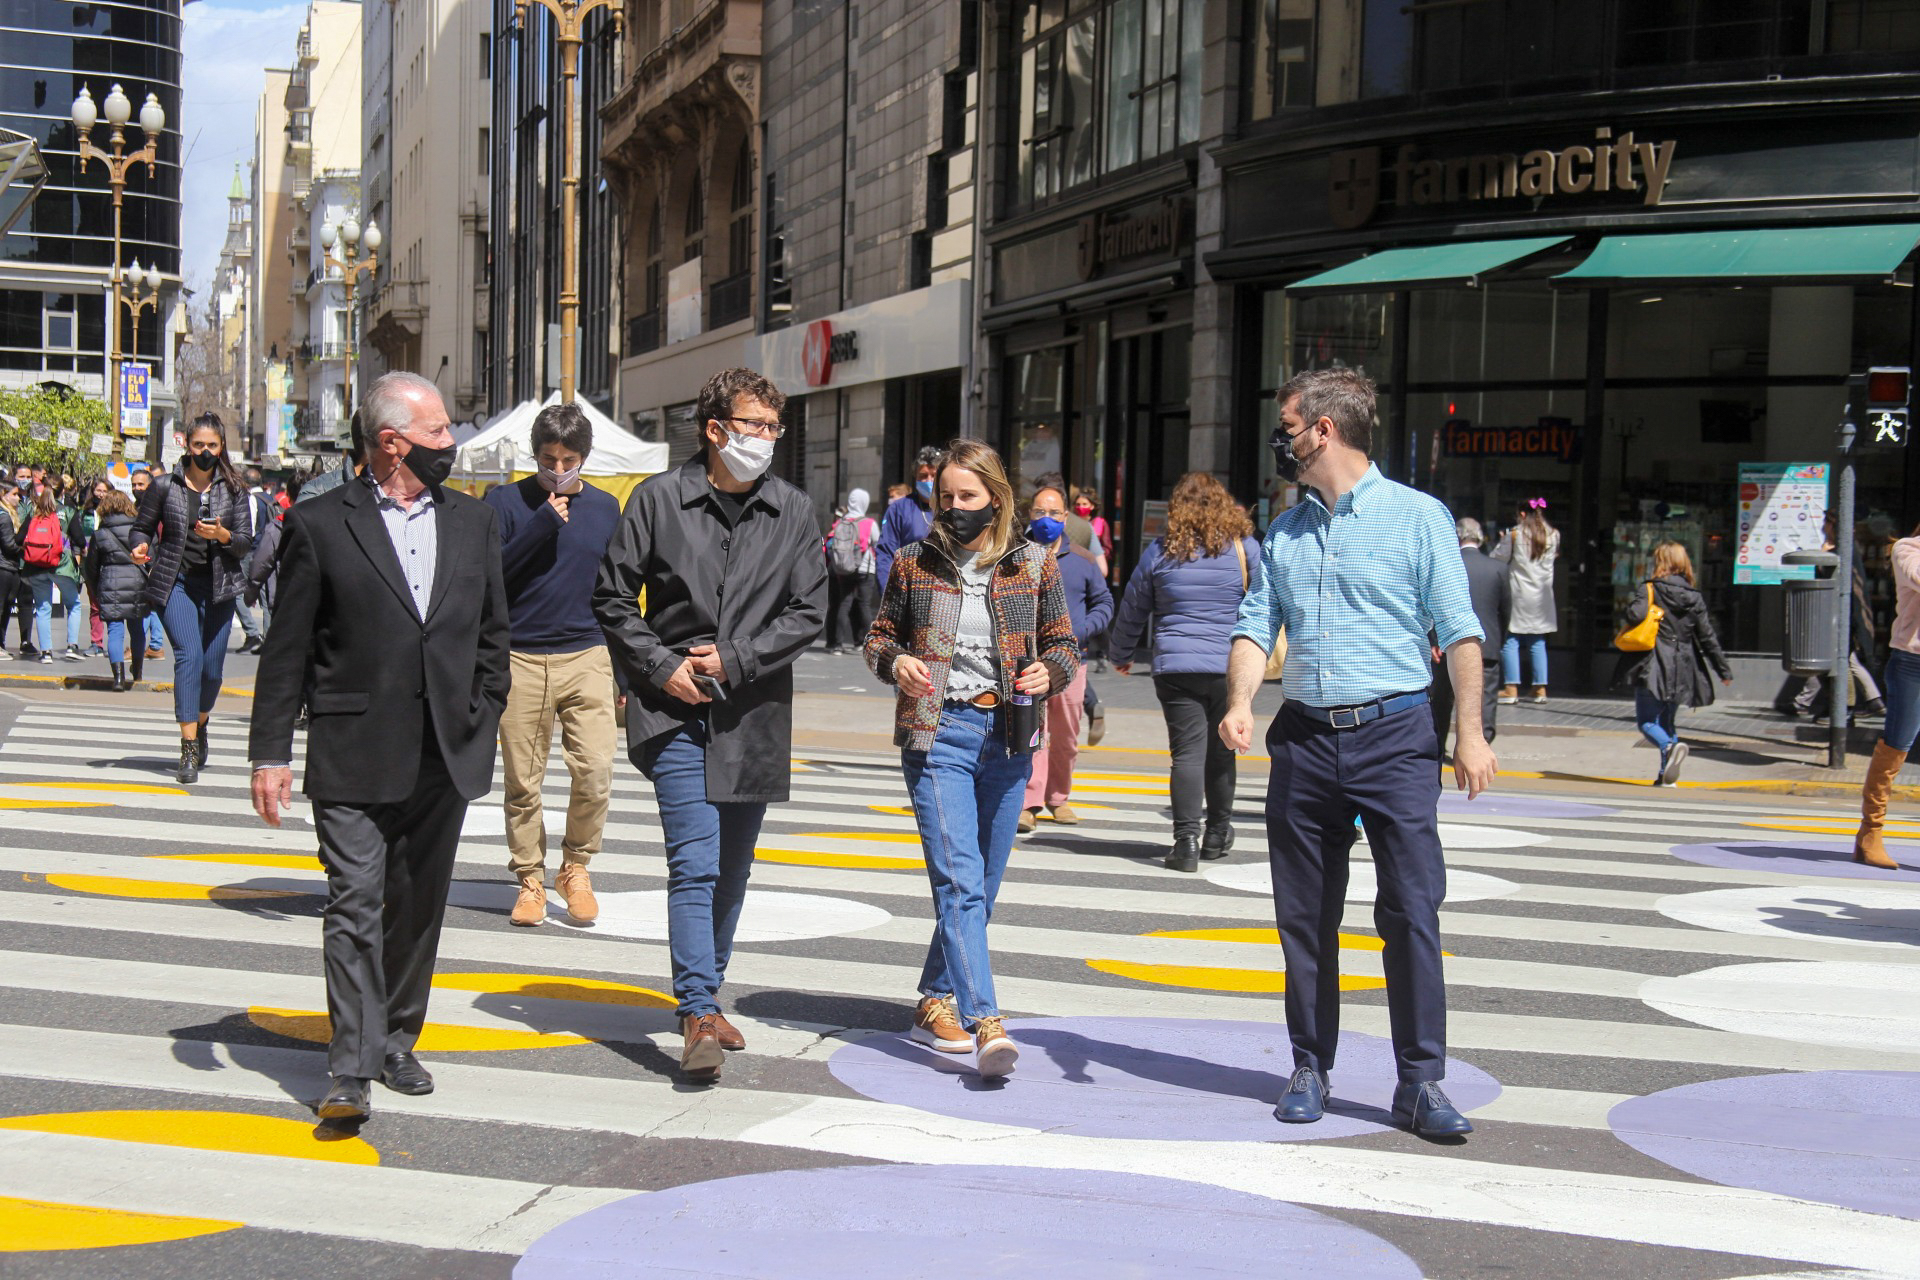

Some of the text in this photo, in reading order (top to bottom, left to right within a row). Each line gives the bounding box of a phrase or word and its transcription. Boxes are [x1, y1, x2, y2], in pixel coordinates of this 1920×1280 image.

[1392, 126, 1676, 206] farmacity
[1099, 195, 1181, 262] farmacity
[128, 374, 145, 384] FLO
[128, 384, 138, 393] RI
[128, 393, 143, 402] DA
[1447, 420, 1575, 459] farmacity
